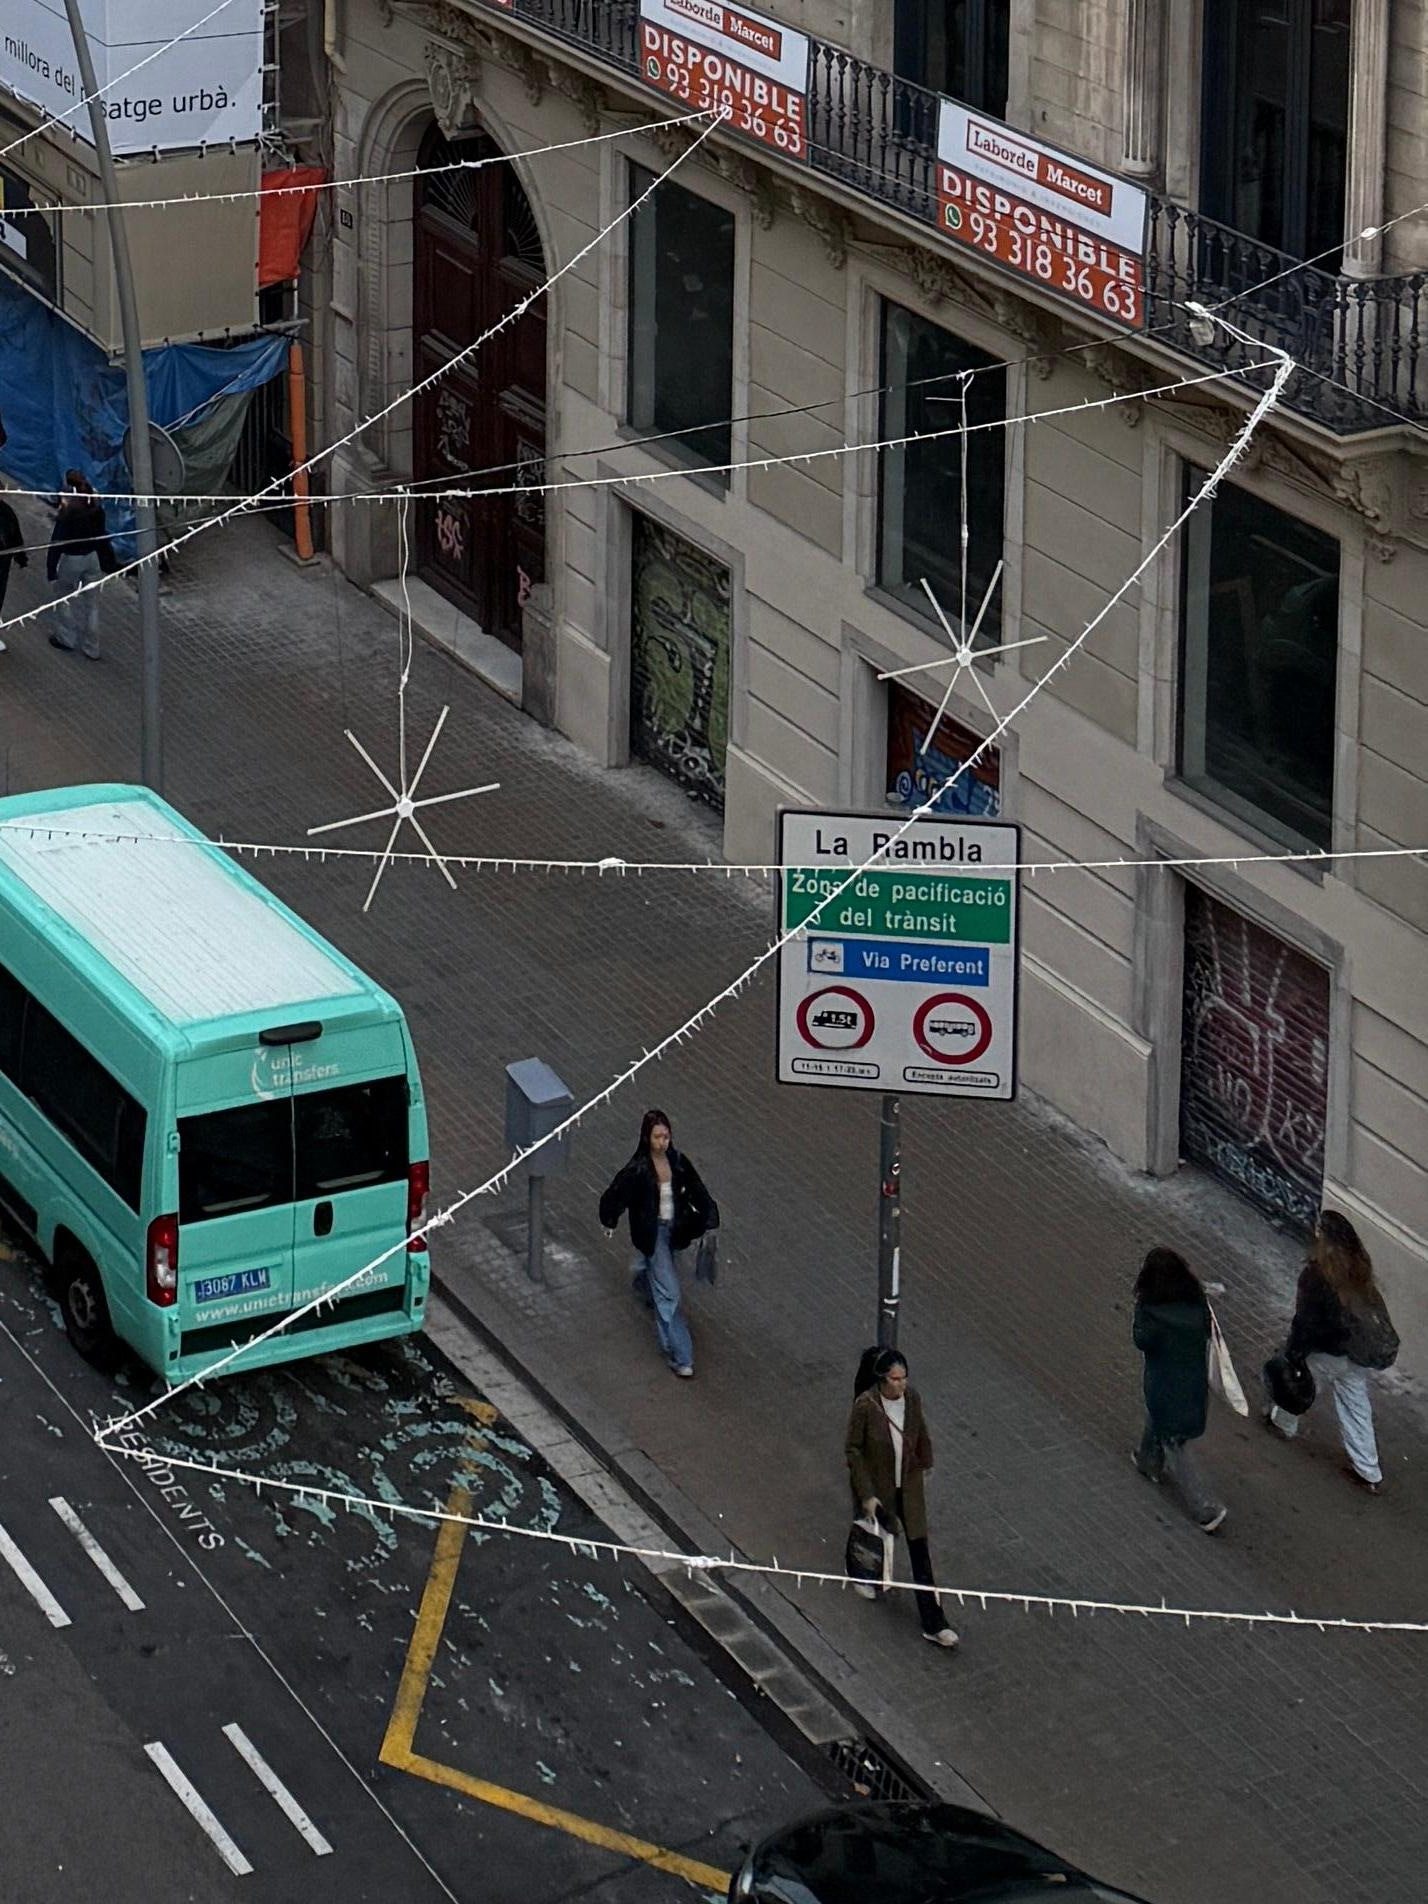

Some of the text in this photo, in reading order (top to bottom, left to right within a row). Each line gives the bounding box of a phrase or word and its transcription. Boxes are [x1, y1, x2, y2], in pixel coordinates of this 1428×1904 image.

[730, 16, 774, 51] Marcet
[4, 35, 51, 78] millora
[55, 69, 76, 97] del
[173, 84, 237, 113] urbà.
[644, 24, 801, 122] DISPONIBLE
[666, 63, 801, 154] 93 318 36 63
[973, 130, 1036, 173] Laborde
[1047, 163, 1103, 206] Marcet
[943, 168, 1137, 284] DISPONIBLE
[969, 213, 1137, 321] 93 318 36 63
[816, 829, 982, 863] La Rambla
[792, 874, 1006, 907] Zona de pacificació
[840, 906, 957, 933] del trànsit
[862, 950, 984, 976] Via Preferent
